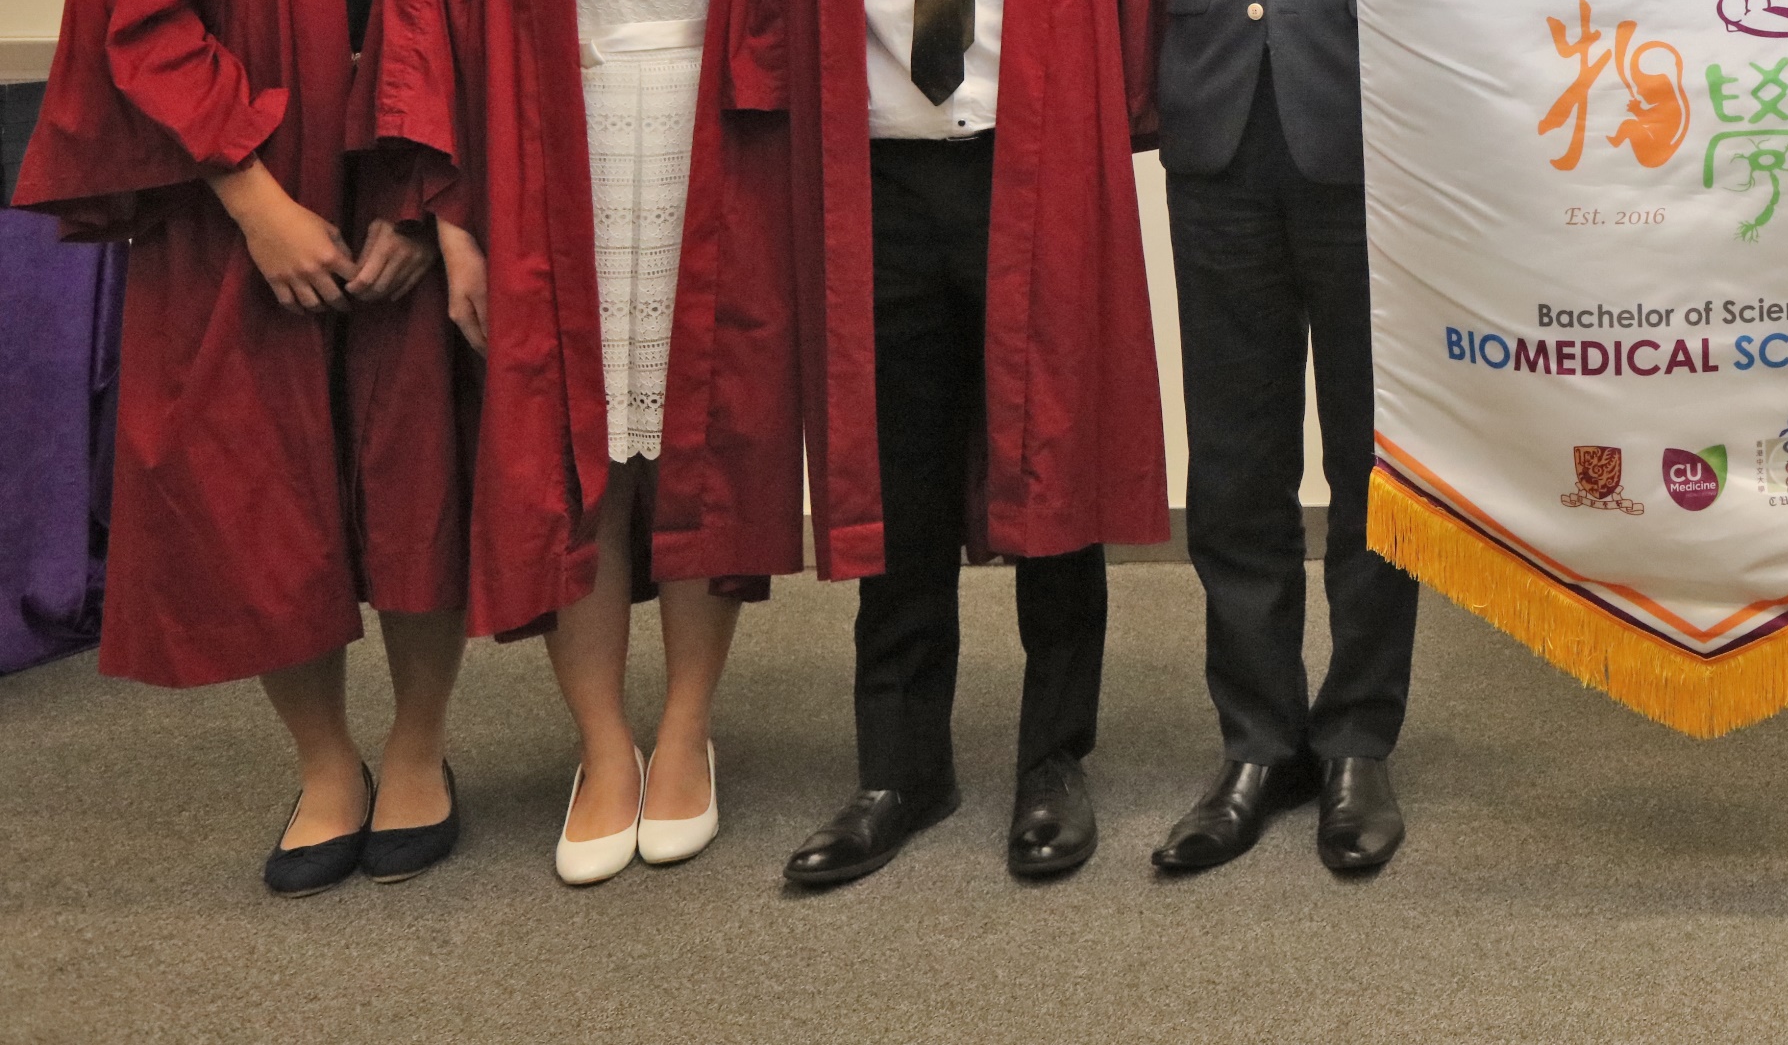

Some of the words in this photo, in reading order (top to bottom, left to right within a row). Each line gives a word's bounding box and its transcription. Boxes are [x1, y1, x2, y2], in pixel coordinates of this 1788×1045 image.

[1564, 207, 1606, 226] Est.
[1614, 207, 1666, 226] 2016
[1537, 302, 1675, 329] Bachelor
[1684, 300, 1713, 327] of
[1445, 325, 1720, 376] BIOMEDICAL
[1669, 463, 1703, 482] CU
[1670, 481, 1717, 493] Medicine
